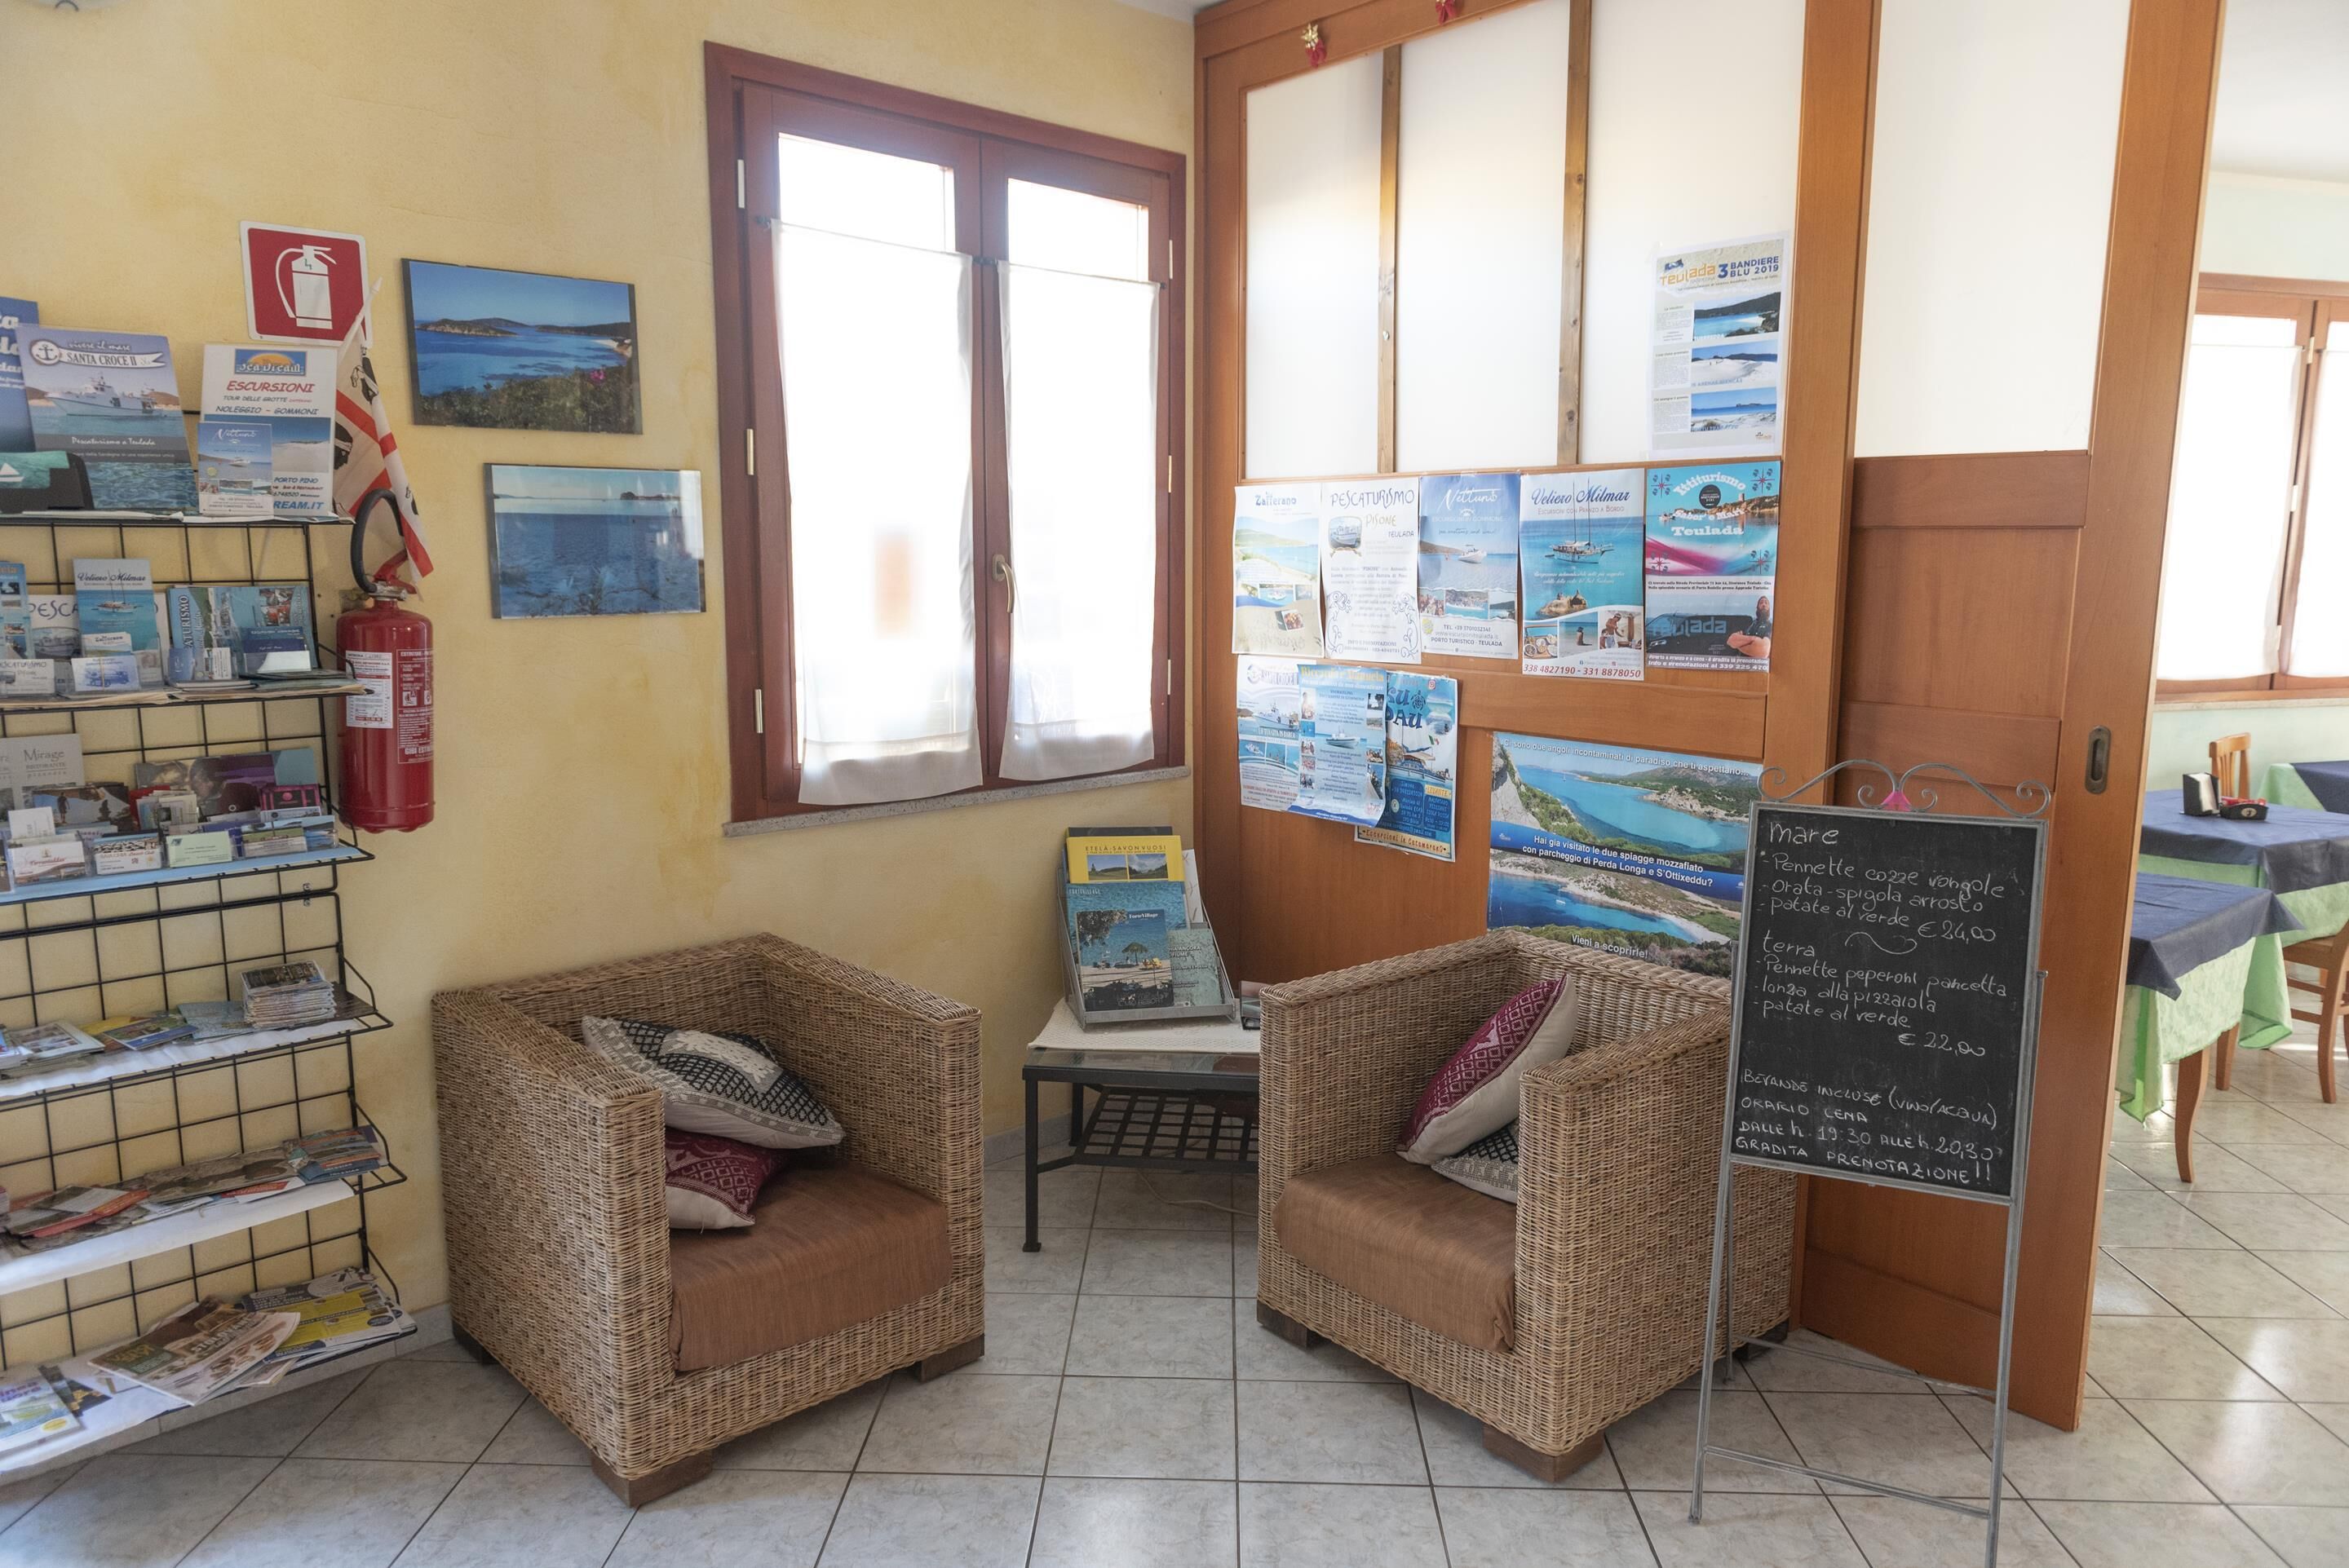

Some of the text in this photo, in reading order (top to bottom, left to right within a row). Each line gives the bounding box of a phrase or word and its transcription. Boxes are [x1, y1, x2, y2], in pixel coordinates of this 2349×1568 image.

[1718, 263, 1728, 279] 3
[1730, 256, 1779, 270] BANDIERE
[1730, 263, 1779, 278] BLU 2019
[67, 351, 97, 364] SANTA
[99, 354, 129, 366] CROCE
[226, 380, 316, 393] ESCURSIONI
[215, 405, 262, 413] NOLEGGIO
[274, 407, 320, 415] GOMMONI
[127, 437, 157, 446] Teulada
[1330, 488, 1415, 509] PESCATURISMO
[1531, 484, 1630, 505] Veliero Milmar
[1365, 513, 1396, 528] PISONE
[1670, 525, 1745, 537] Teulada
[1523, 664, 1537, 673] 338
[1540, 665, 1576, 675] 4827190
[1583, 667, 1599, 676] 331
[1601, 669, 1641, 678] 8878050
[24, 749, 65, 762] Mirage
[1504, 738, 1511, 748] Ci
[1513, 740, 1532, 750] sono
[1532, 741, 1546, 752] due
[1548, 744, 1570, 756] angoli
[1572, 747, 1624, 762] incontaminati
[1626, 753, 1633, 762] di
[1636, 755, 1671, 767] paradiso
[1673, 760, 1688, 771] che
[1522, 845, 1537, 855] con
[1538, 848, 1582, 864] parcheggio
[1583, 855, 1591, 865] di
[1592, 858, 1617, 870] Perda
[1619, 863, 1647, 876] Longa
[1648, 868, 1655, 877] e
[1533, 834, 1547, 846] Hai
[1562, 840, 1590, 854] visitato
[1592, 845, 1600, 855] le
[1601, 847, 1618, 859] due
[1619, 851, 1655, 866] spiagge
[1656, 858, 1704, 874] mozzafiato
[1865, 869, 1919, 886] cozze
[1909, 891, 1984, 913] arrosto
[1836, 903, 1853, 920] al
[1858, 907, 1910, 928] verde
[1918, 921, 1938, 939] €
[1572, 934, 1648, 959] Vieni a scoprirle!
[1763, 930, 1815, 958] terra
[1846, 968, 1918, 989] peperoni
[1927, 973, 2006, 998] pancetta
[1817, 982, 1849, 1002] alla
[1854, 990, 1936, 1014] pizzaiola
[1829, 1004, 1849, 1022] al
[1856, 1010, 1911, 1029] verde
[1898, 1032, 1917, 1046] €
[1742, 1068, 1808, 1093] BEVANDE
[1818, 1084, 1882, 1106] INCLUSE
[1741, 1097, 1869, 1124] ORARIO CENA
[1739, 1120, 1785, 1137] DALLE
[1880, 1133, 1915, 1150] ALLE
[1735, 1136, 1808, 1158] GRADITA
